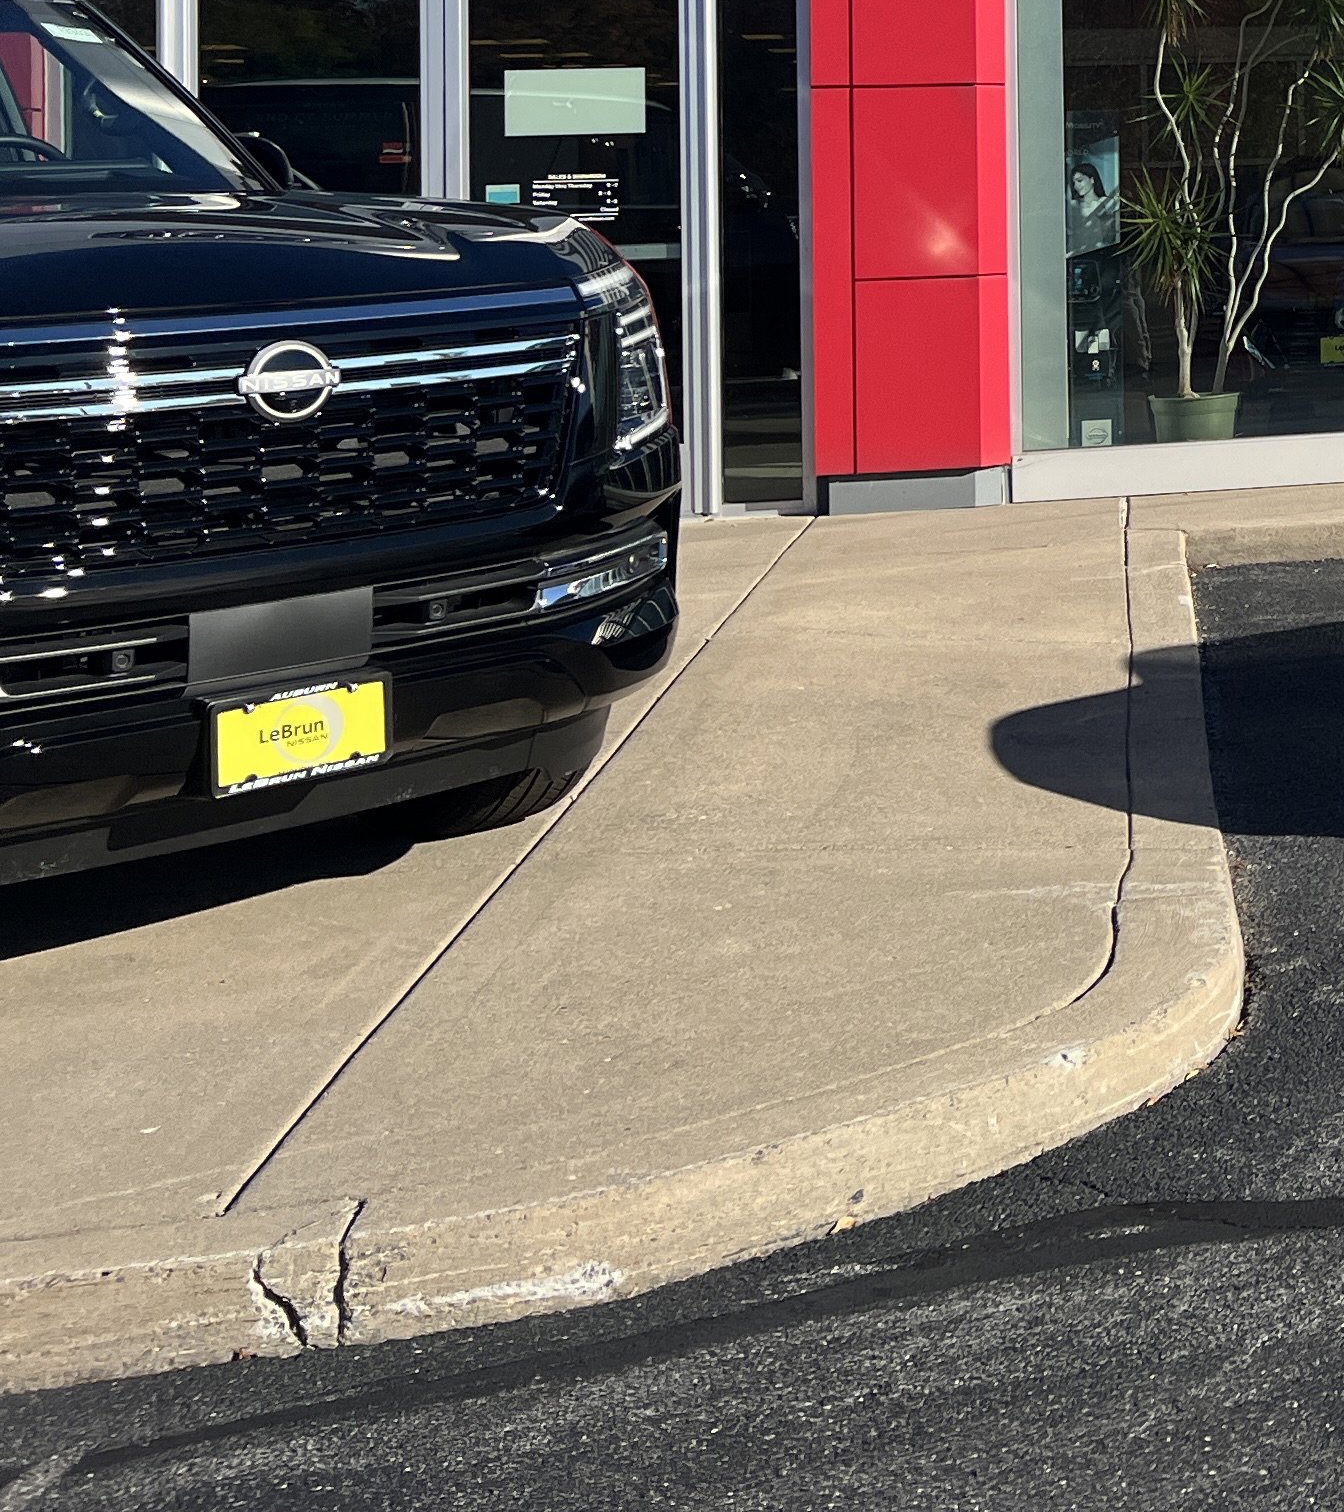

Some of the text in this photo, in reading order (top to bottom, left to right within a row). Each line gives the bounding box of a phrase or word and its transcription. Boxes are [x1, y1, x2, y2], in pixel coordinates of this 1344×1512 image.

[241, 371, 340, 393] NISSAN
[269, 681, 339, 702] AUBURN
[259, 720, 324, 744] LeBrun
[286, 733, 328, 747] NISSAN
